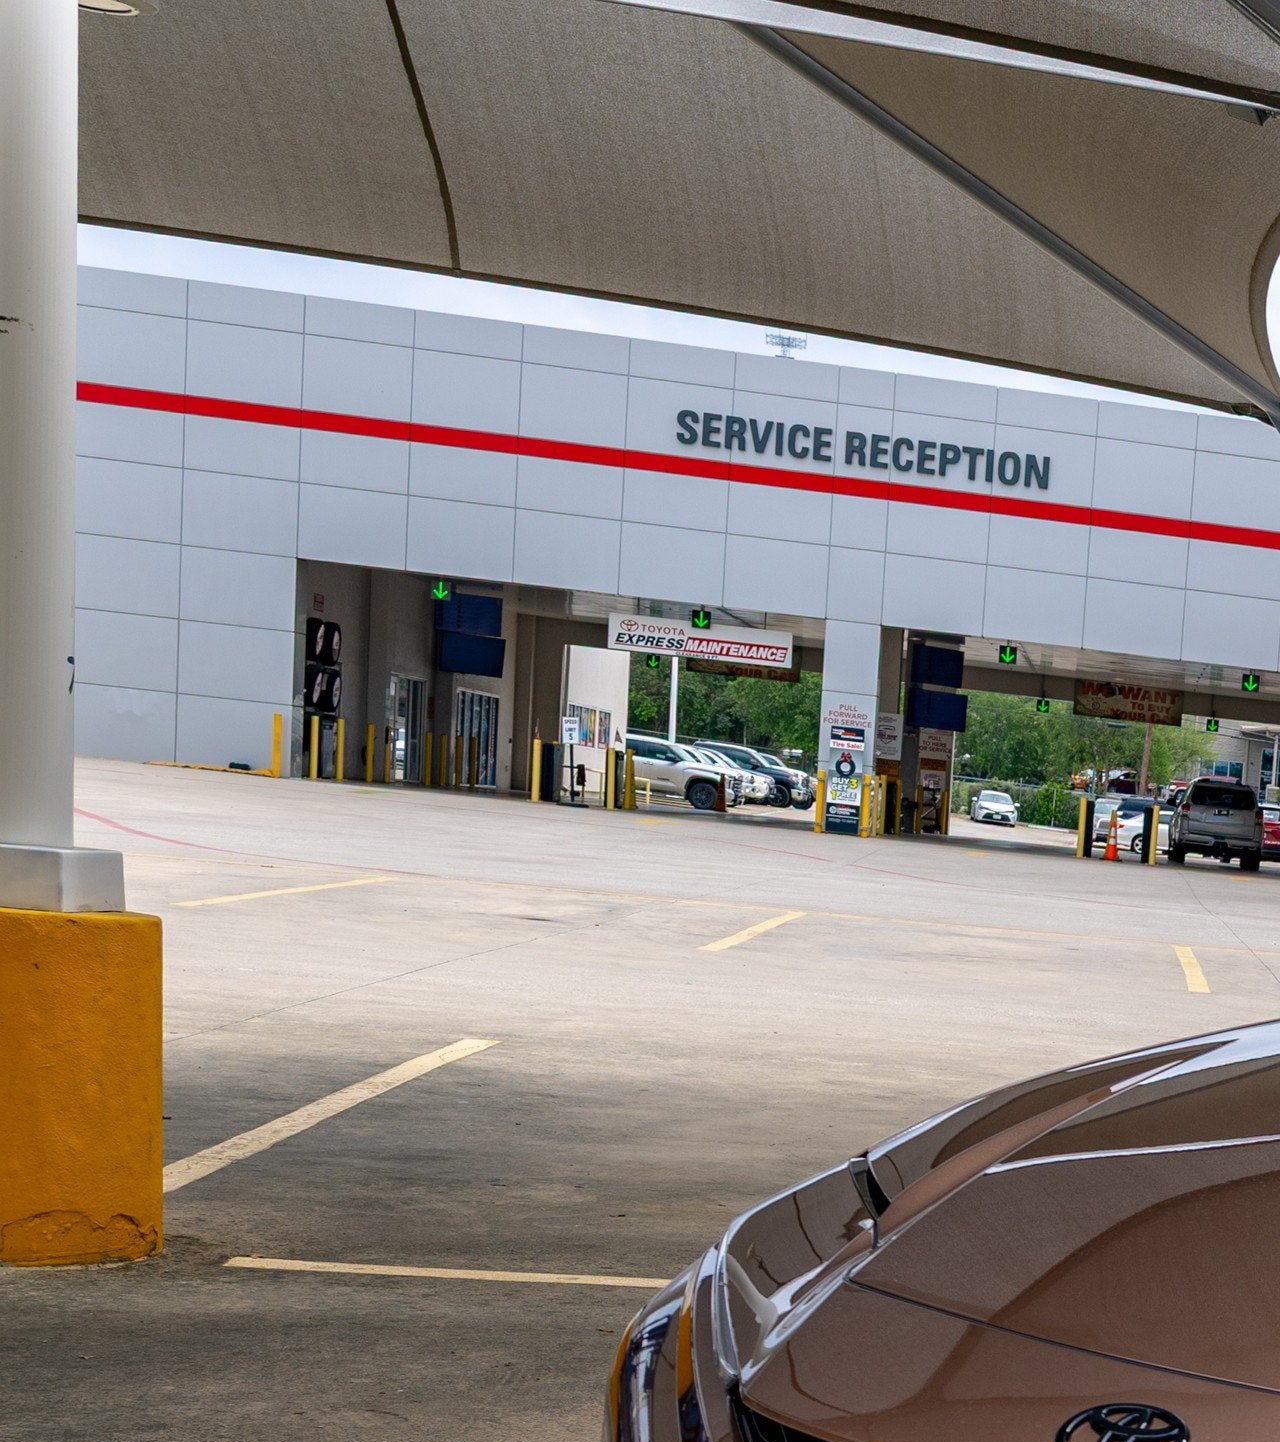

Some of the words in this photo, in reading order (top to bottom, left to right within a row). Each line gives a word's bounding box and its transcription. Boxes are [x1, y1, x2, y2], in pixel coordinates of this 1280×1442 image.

[675, 408, 834, 463] SERVICE
[844, 430, 1051, 491] RECEPTION
[641, 623, 686, 636] TOYOTA
[615, 632, 686, 649] EXPRESS
[685, 637, 788, 663] MAINTENANCE
[1120, 685, 1179, 704] WANT
[840, 704, 858, 712] PULL
[1130, 701, 1144, 711] TO
[1148, 704, 1171, 714] BUY
[828, 710, 868, 720] FORWARD
[841, 718, 872, 728] SERVICE
[831, 776, 849, 784] BUY
[850, 778, 858, 789] 3
